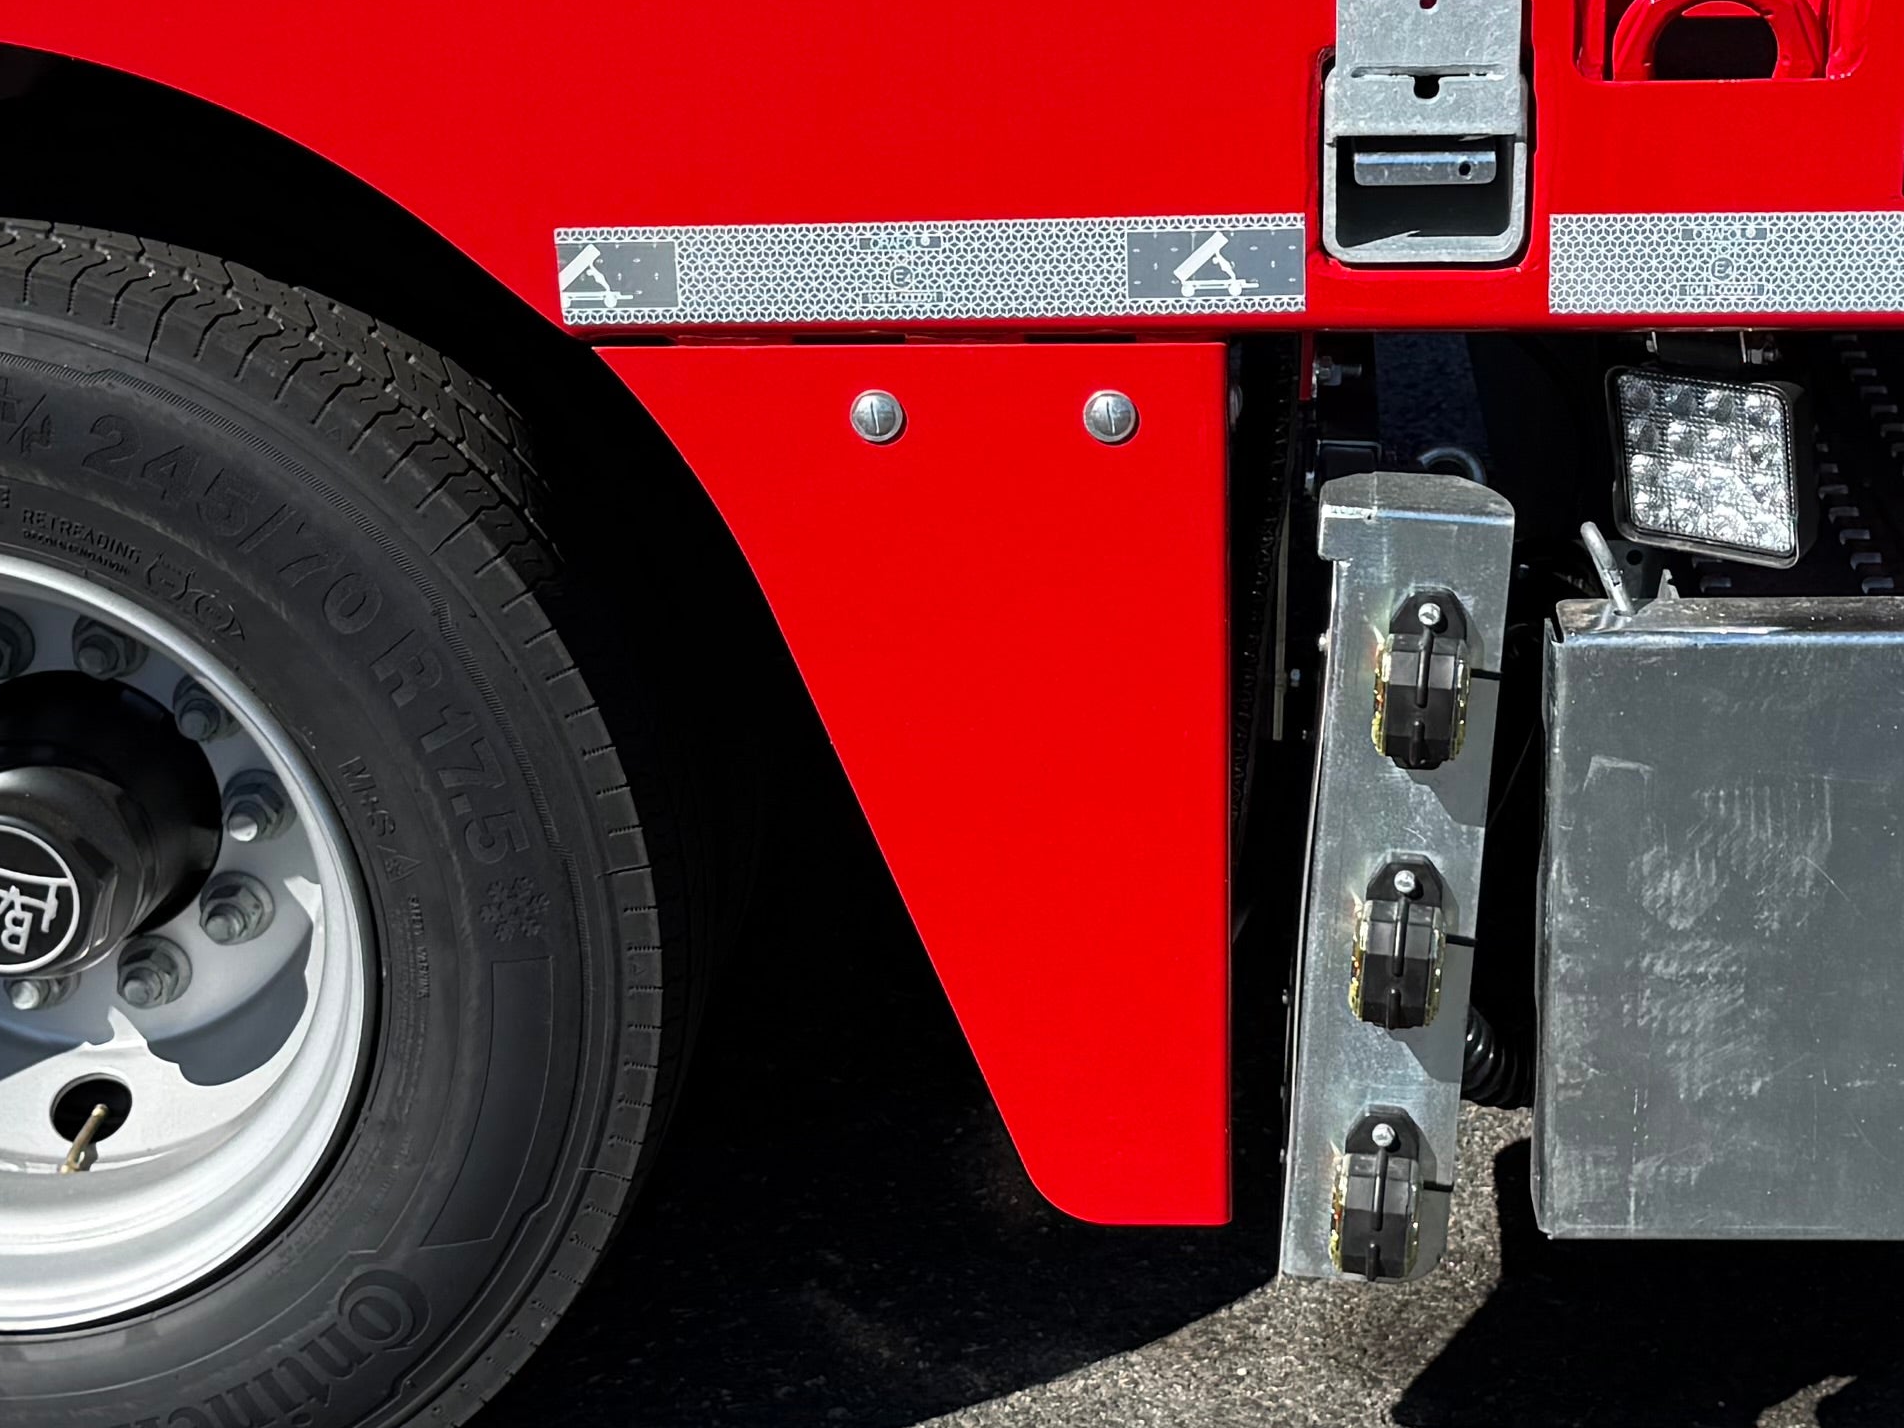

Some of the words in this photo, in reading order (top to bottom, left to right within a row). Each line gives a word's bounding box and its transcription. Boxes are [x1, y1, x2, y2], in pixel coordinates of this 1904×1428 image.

[21, 508, 142, 565] RETREADING
[81, 414, 384, 634] 245/70
[420, 703, 531, 864] 17.5
